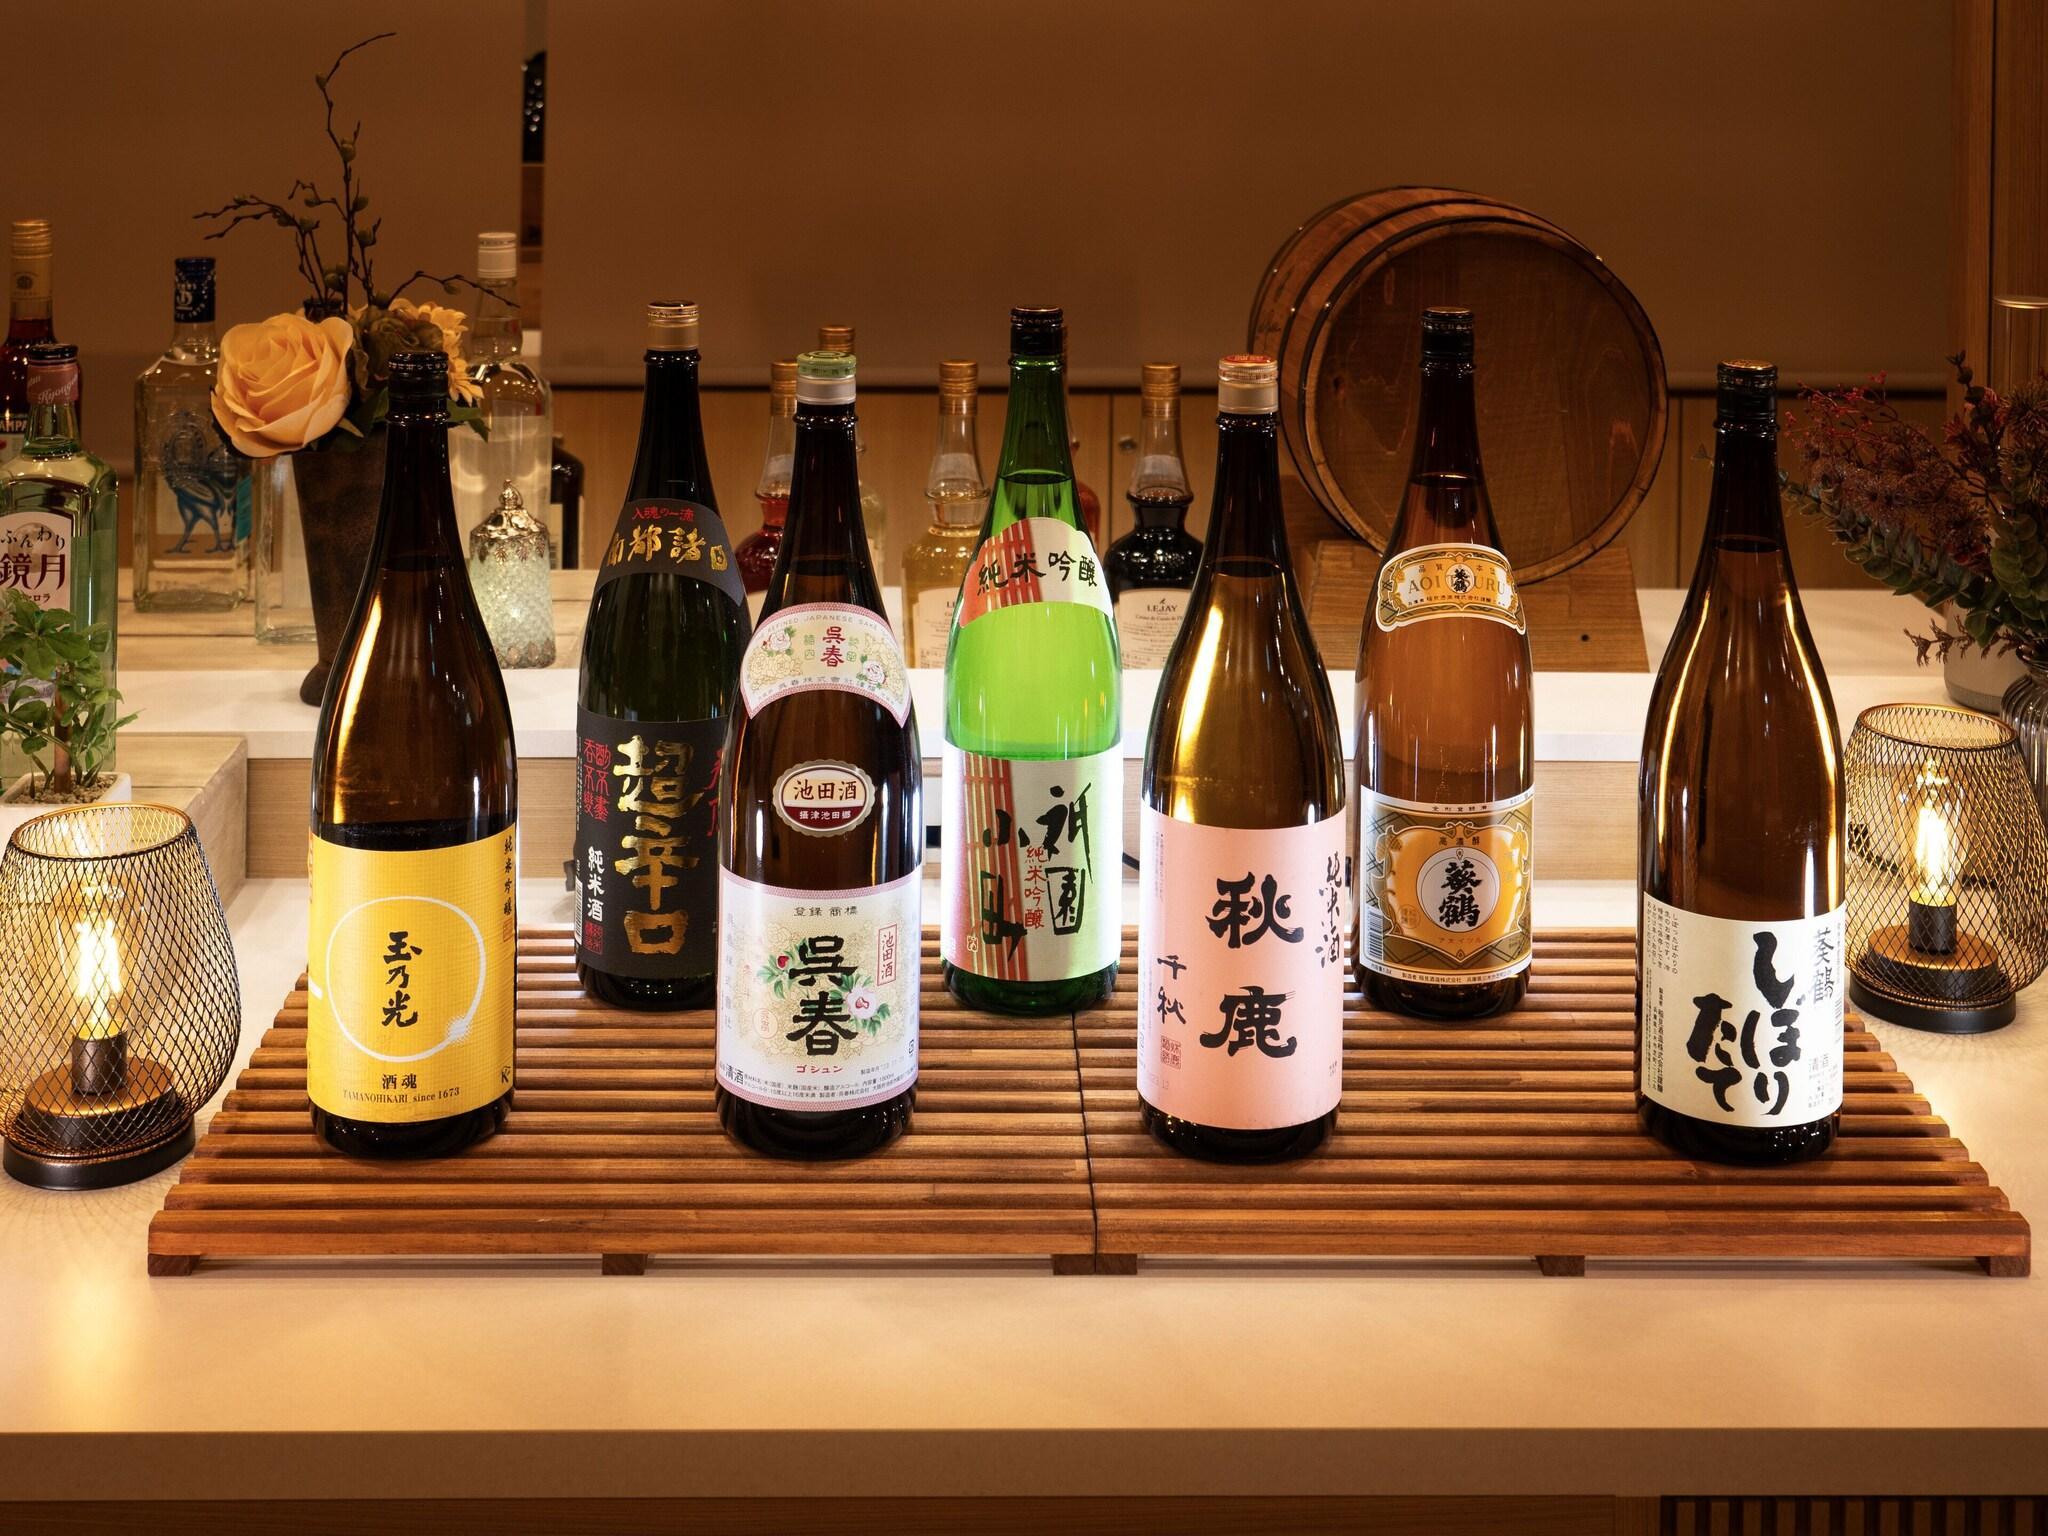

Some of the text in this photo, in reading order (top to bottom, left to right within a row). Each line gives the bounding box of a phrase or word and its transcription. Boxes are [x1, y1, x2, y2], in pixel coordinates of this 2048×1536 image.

[1, 526, 66, 552] ふんわり
[0, 553, 66, 590] 鏡月
[1408, 575, 1440, 594] AOI
[804, 614, 853, 624] JAPANESE
[820, 626, 846, 668] 呉春
[794, 779, 857, 801] 池田酒
[613, 735, 704, 955] 超辛口
[587, 846, 605, 922] 純米酒
[1439, 860, 1482, 928] 葵鶴
[381, 931, 423, 1028] 玉乃光
[881, 931, 894, 980] 池田酒
[1200, 872, 1304, 1058] 秋鹿
[785, 935, 859, 1056] 呉春
[1157, 955, 1187, 1025] 千秋
[1739, 931, 1806, 1116] しぼり
[796, 1065, 843, 1075] ゴシュン
[1687, 993, 1742, 1112] たて
[343, 1087, 460, 1104] TAMANOHIKARI since 1673
[382, 1073, 417, 1090] 酒魂
